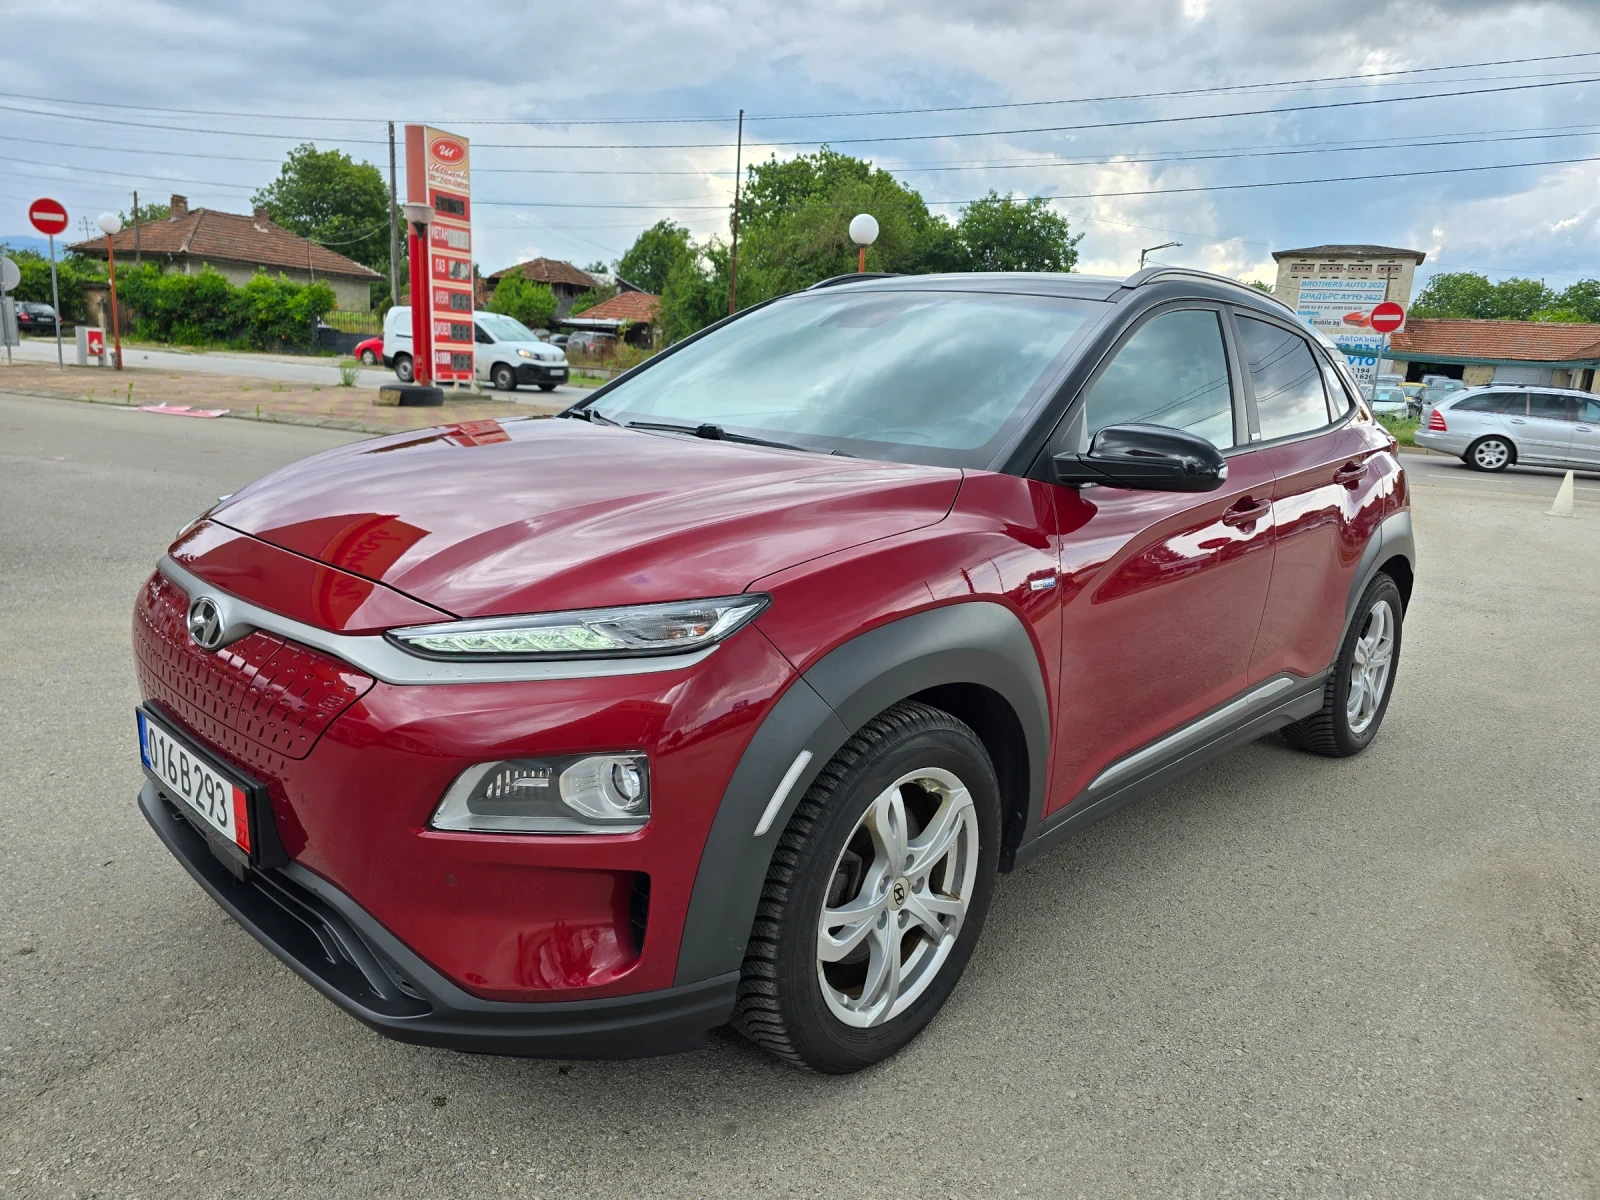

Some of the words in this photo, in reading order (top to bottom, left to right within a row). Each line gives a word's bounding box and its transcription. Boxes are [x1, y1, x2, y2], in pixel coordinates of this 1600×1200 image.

[1301, 280, 1343, 289] BROTHERS
[1344, 281, 1367, 289] AUTO
[1368, 281, 1386, 289] 2022
[1300, 292, 1340, 301] БРАДЪРС
[1340, 293, 1362, 301] АУТО
[1313, 319, 1340, 327] mobile.bg
[1339, 334, 1382, 343] Автокъща
